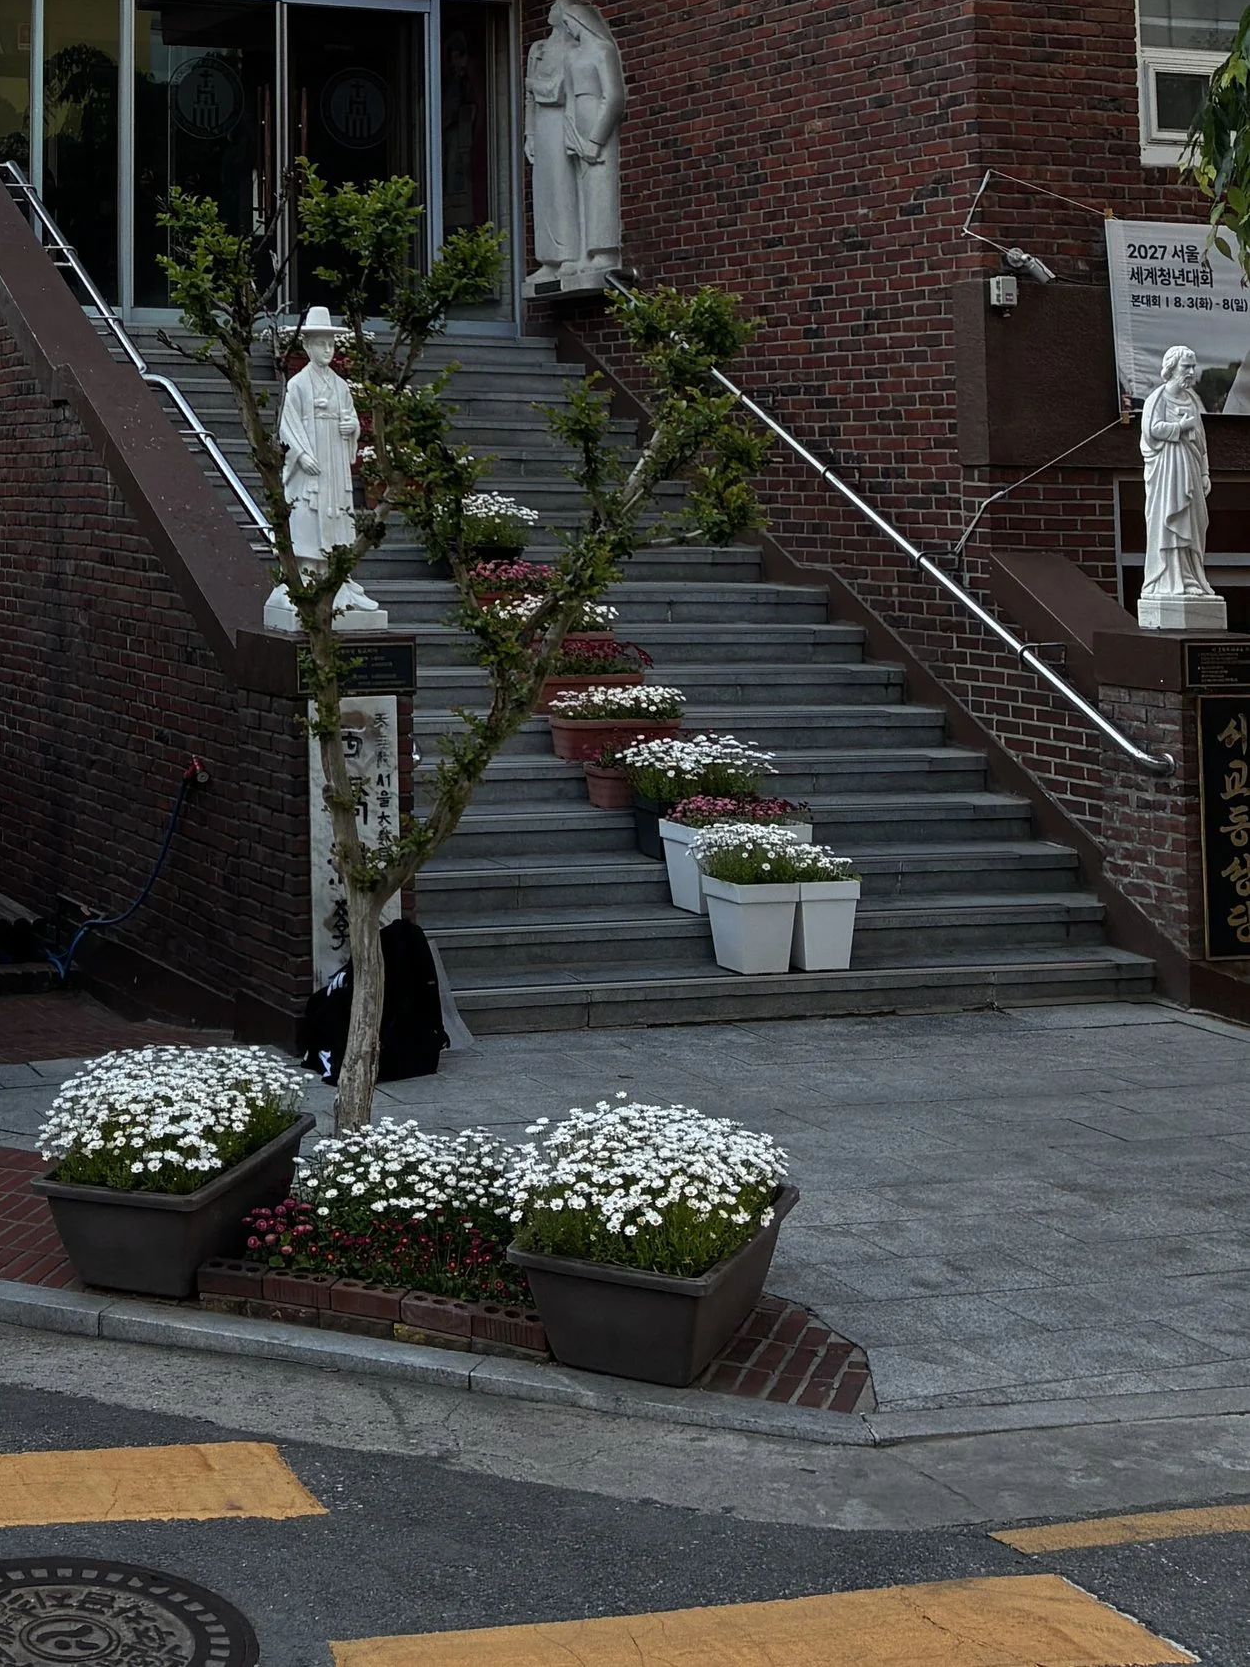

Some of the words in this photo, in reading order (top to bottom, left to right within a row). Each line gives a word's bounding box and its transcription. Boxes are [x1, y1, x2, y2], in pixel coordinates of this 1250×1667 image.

[1126, 243, 1168, 261] 2027
[1171, 243, 1200, 264] 서울
[1129, 266, 1214, 288] 세계청년대회
[1130, 294, 1161, 309] 본대회
[1222, 298, 1249, 313] 8(일)
